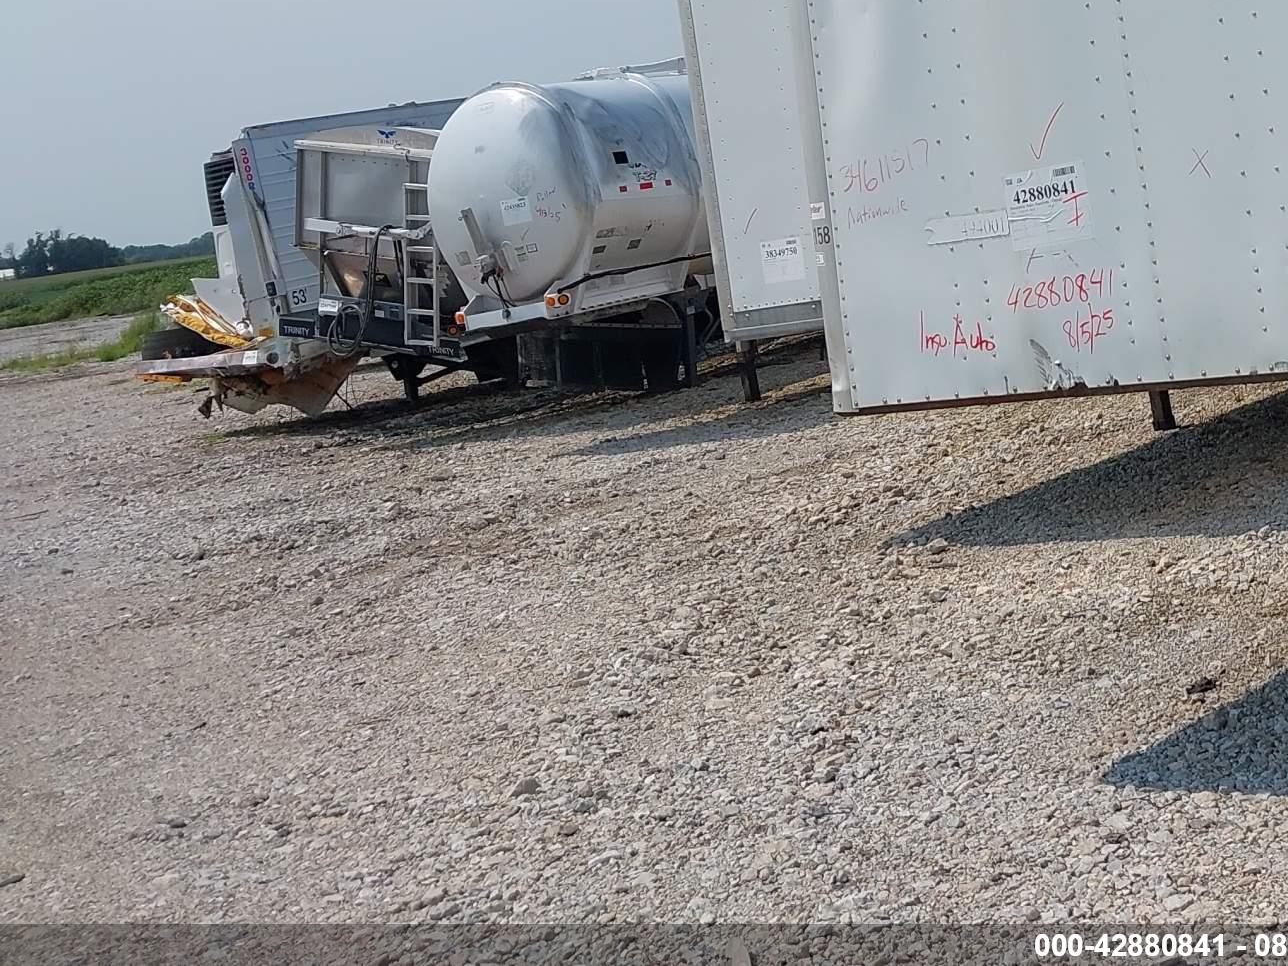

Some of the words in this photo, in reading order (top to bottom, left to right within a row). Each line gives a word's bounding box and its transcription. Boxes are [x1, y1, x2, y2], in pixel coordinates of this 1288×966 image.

[1012, 178, 1077, 205] 42880841
[1006, 268, 1113, 314] 42880841
[283, 325, 311, 337] TRINITY
[427, 345, 455, 356] TRINITY
